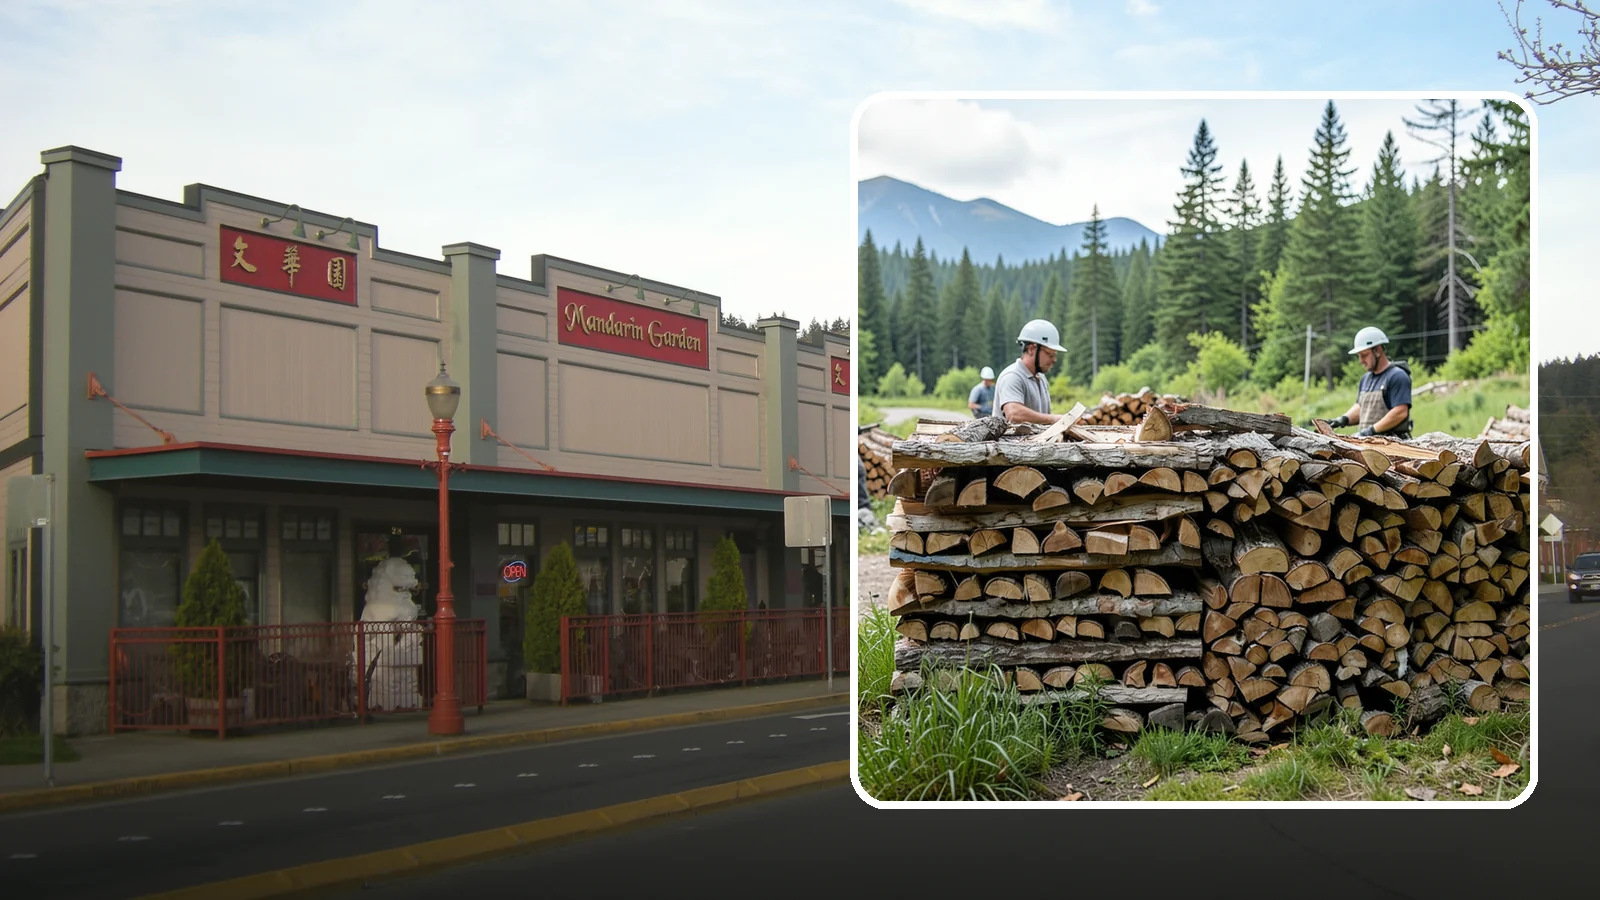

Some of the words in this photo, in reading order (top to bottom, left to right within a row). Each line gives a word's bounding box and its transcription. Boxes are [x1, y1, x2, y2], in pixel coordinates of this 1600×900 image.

[231, 236, 346, 291] 文華園
[564, 302, 644, 341] Mandarin
[648, 320, 702, 352] Garden
[503, 565, 527, 578] OPEN
